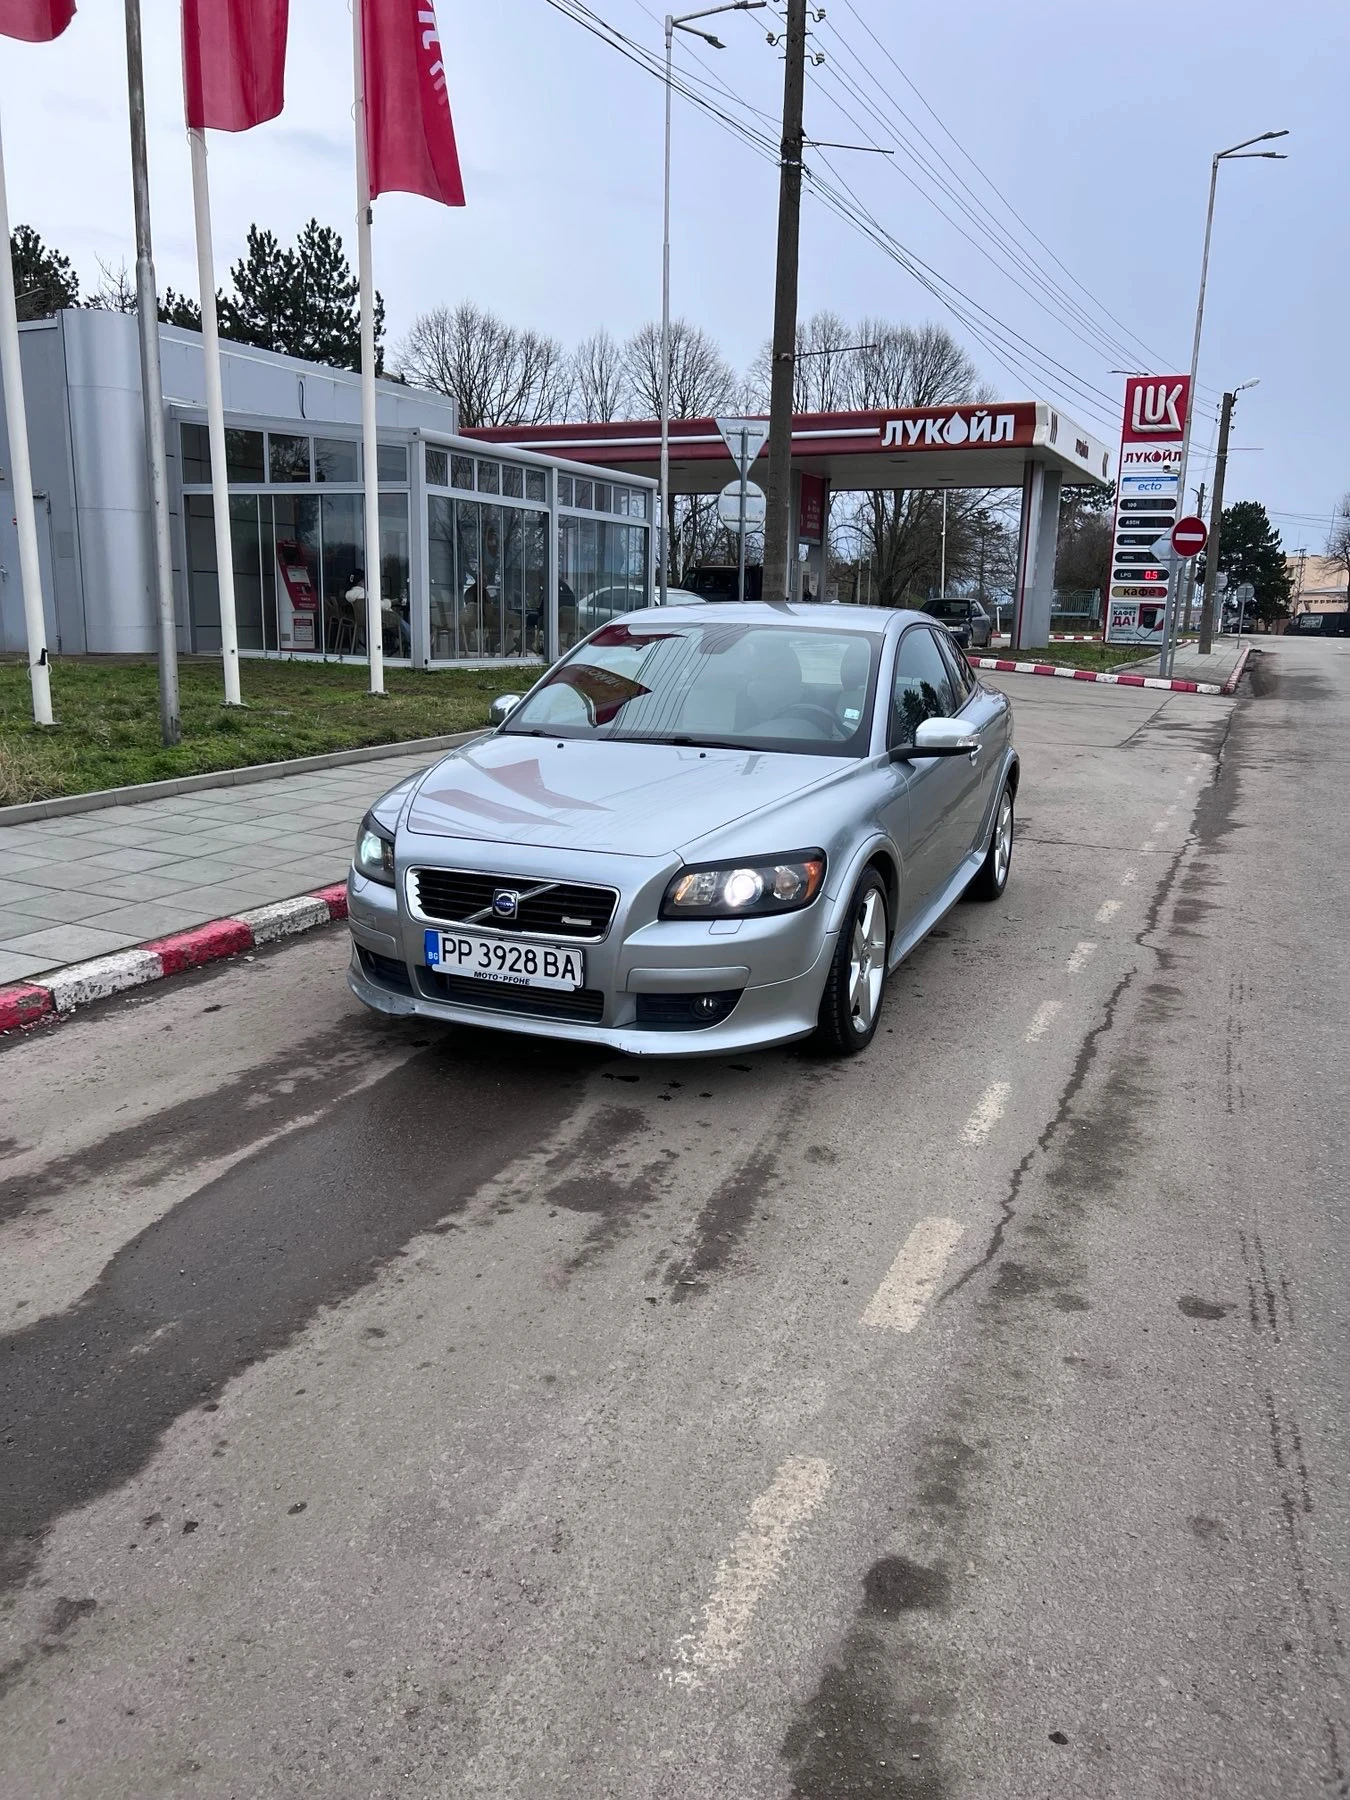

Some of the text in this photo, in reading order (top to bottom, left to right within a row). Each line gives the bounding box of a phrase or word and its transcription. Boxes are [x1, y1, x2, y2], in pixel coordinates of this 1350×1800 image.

[1132, 384, 1183, 433] LUK
[881, 410, 1015, 447] ЛУКОЙЛ
[1124, 449, 1181, 463] ЛУКОЙЛ
[1138, 482, 1162, 491] ecto
[1123, 588, 1156, 597] кафе
[1112, 616, 1136, 627] ДА!
[428, 951, 438, 960] BG
[442, 937, 576, 981] PP 3928 BA
